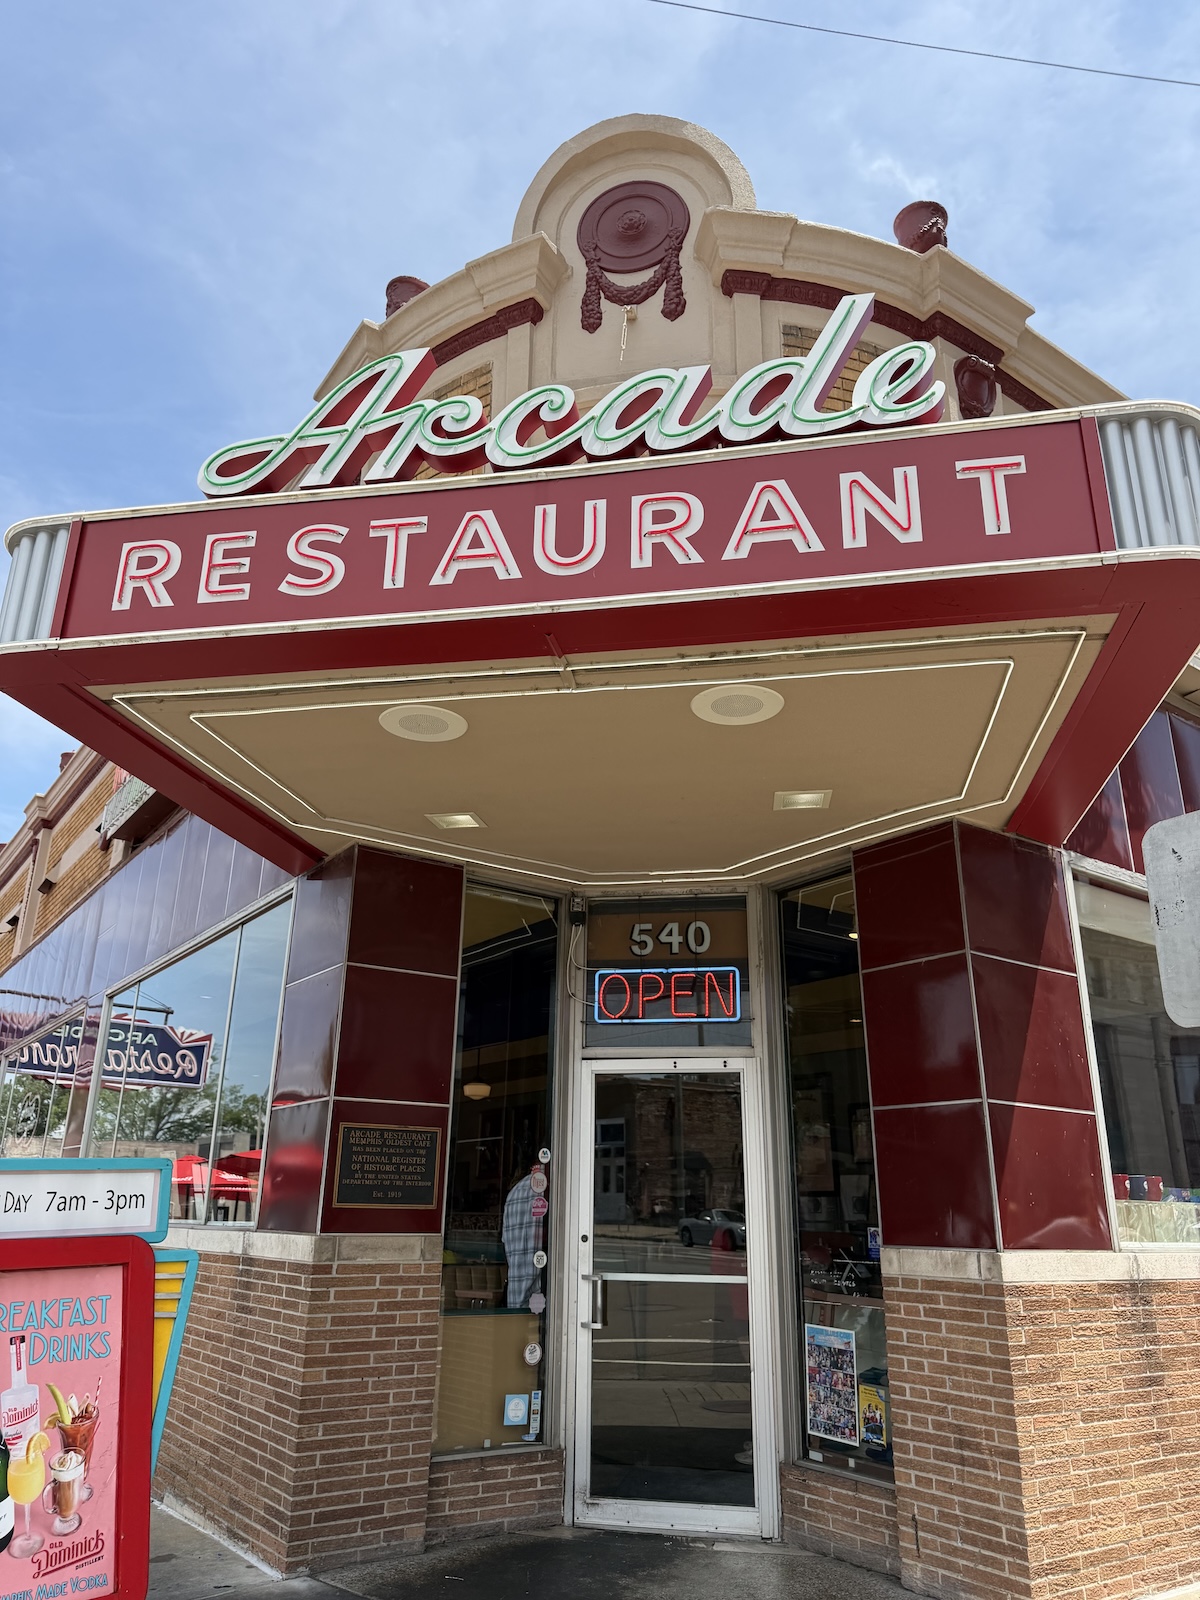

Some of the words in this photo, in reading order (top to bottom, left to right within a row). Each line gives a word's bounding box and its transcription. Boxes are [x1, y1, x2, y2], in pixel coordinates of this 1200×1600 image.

[198, 292, 945, 496] Arcade
[111, 455, 1027, 611] RESTAURANT
[630, 920, 711, 956] 540
[600, 972, 734, 1018] OPEN
[350, 1130, 381, 1138] ARCADE
[384, 1132, 431, 1140] RESTAURANT
[352, 1155, 389, 1163] NATIONAL
[392, 1156, 426, 1164] REGISTER
[400, 1165, 425, 1173] PLACES
[46, 1191, 86, 1212] 7am
[104, 1189, 145, 1215] 3pm
[29, 1331, 111, 1366] DRINKS
[3, 1398, 39, 1428] Dominick
[31, 1529, 105, 1579] Dominick
[49, 1541, 63, 1549] OLD
[75, 1555, 105, 1570] DISTILLERY
[34, 1581, 68, 1600] MADE
[70, 1573, 108, 1593] VODKA
